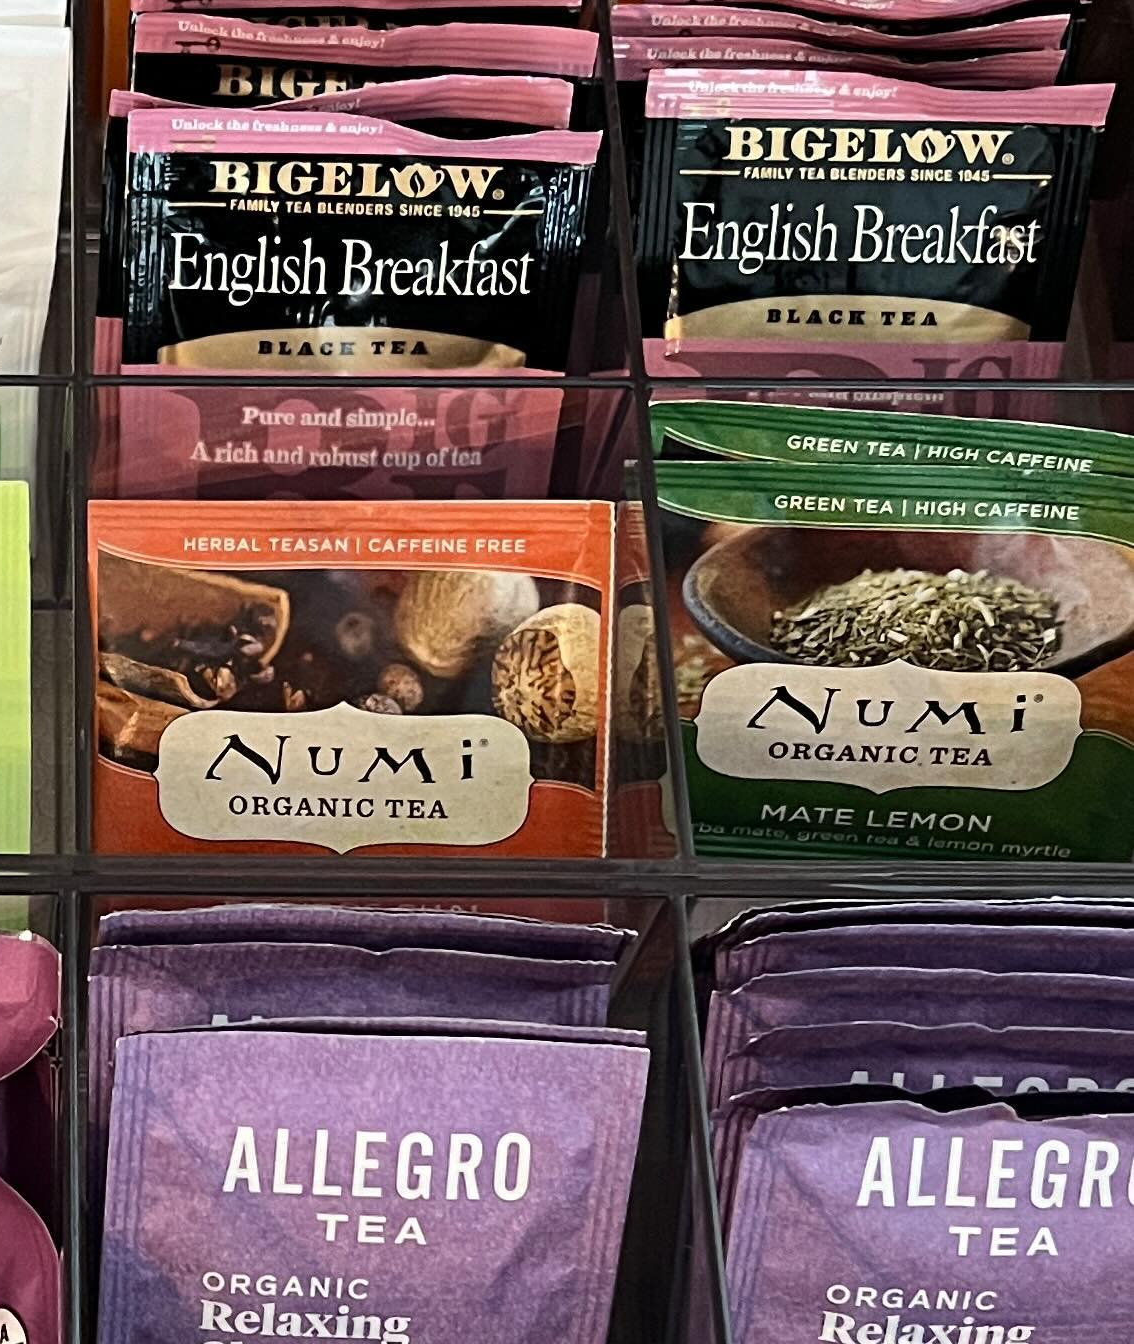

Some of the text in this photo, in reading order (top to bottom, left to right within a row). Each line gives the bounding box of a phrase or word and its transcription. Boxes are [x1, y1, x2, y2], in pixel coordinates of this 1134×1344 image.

[229, 198, 442, 217] FAMILY TEA BLENDERS SINCE
[679, 202, 1040, 275] English Breakfast
[169, 233, 534, 306] English Breakfast
[259, 340, 428, 355] BLACK TEA
[774, 495, 1080, 521] GREEN TEA HIGH CAFFEINE
[183, 537, 526, 553] HERBAL TEASAN CAFFEINE FREE
[769, 742, 992, 767] ORGANIC TEA
[228, 795, 448, 819] ORGANIC TEA
[760, 804, 991, 833] MATE LEMON
[223, 1127, 532, 1201] ALLEGRO
[317, 1212, 427, 1245] TEA
[202, 1272, 370, 1299] ORGANIC
